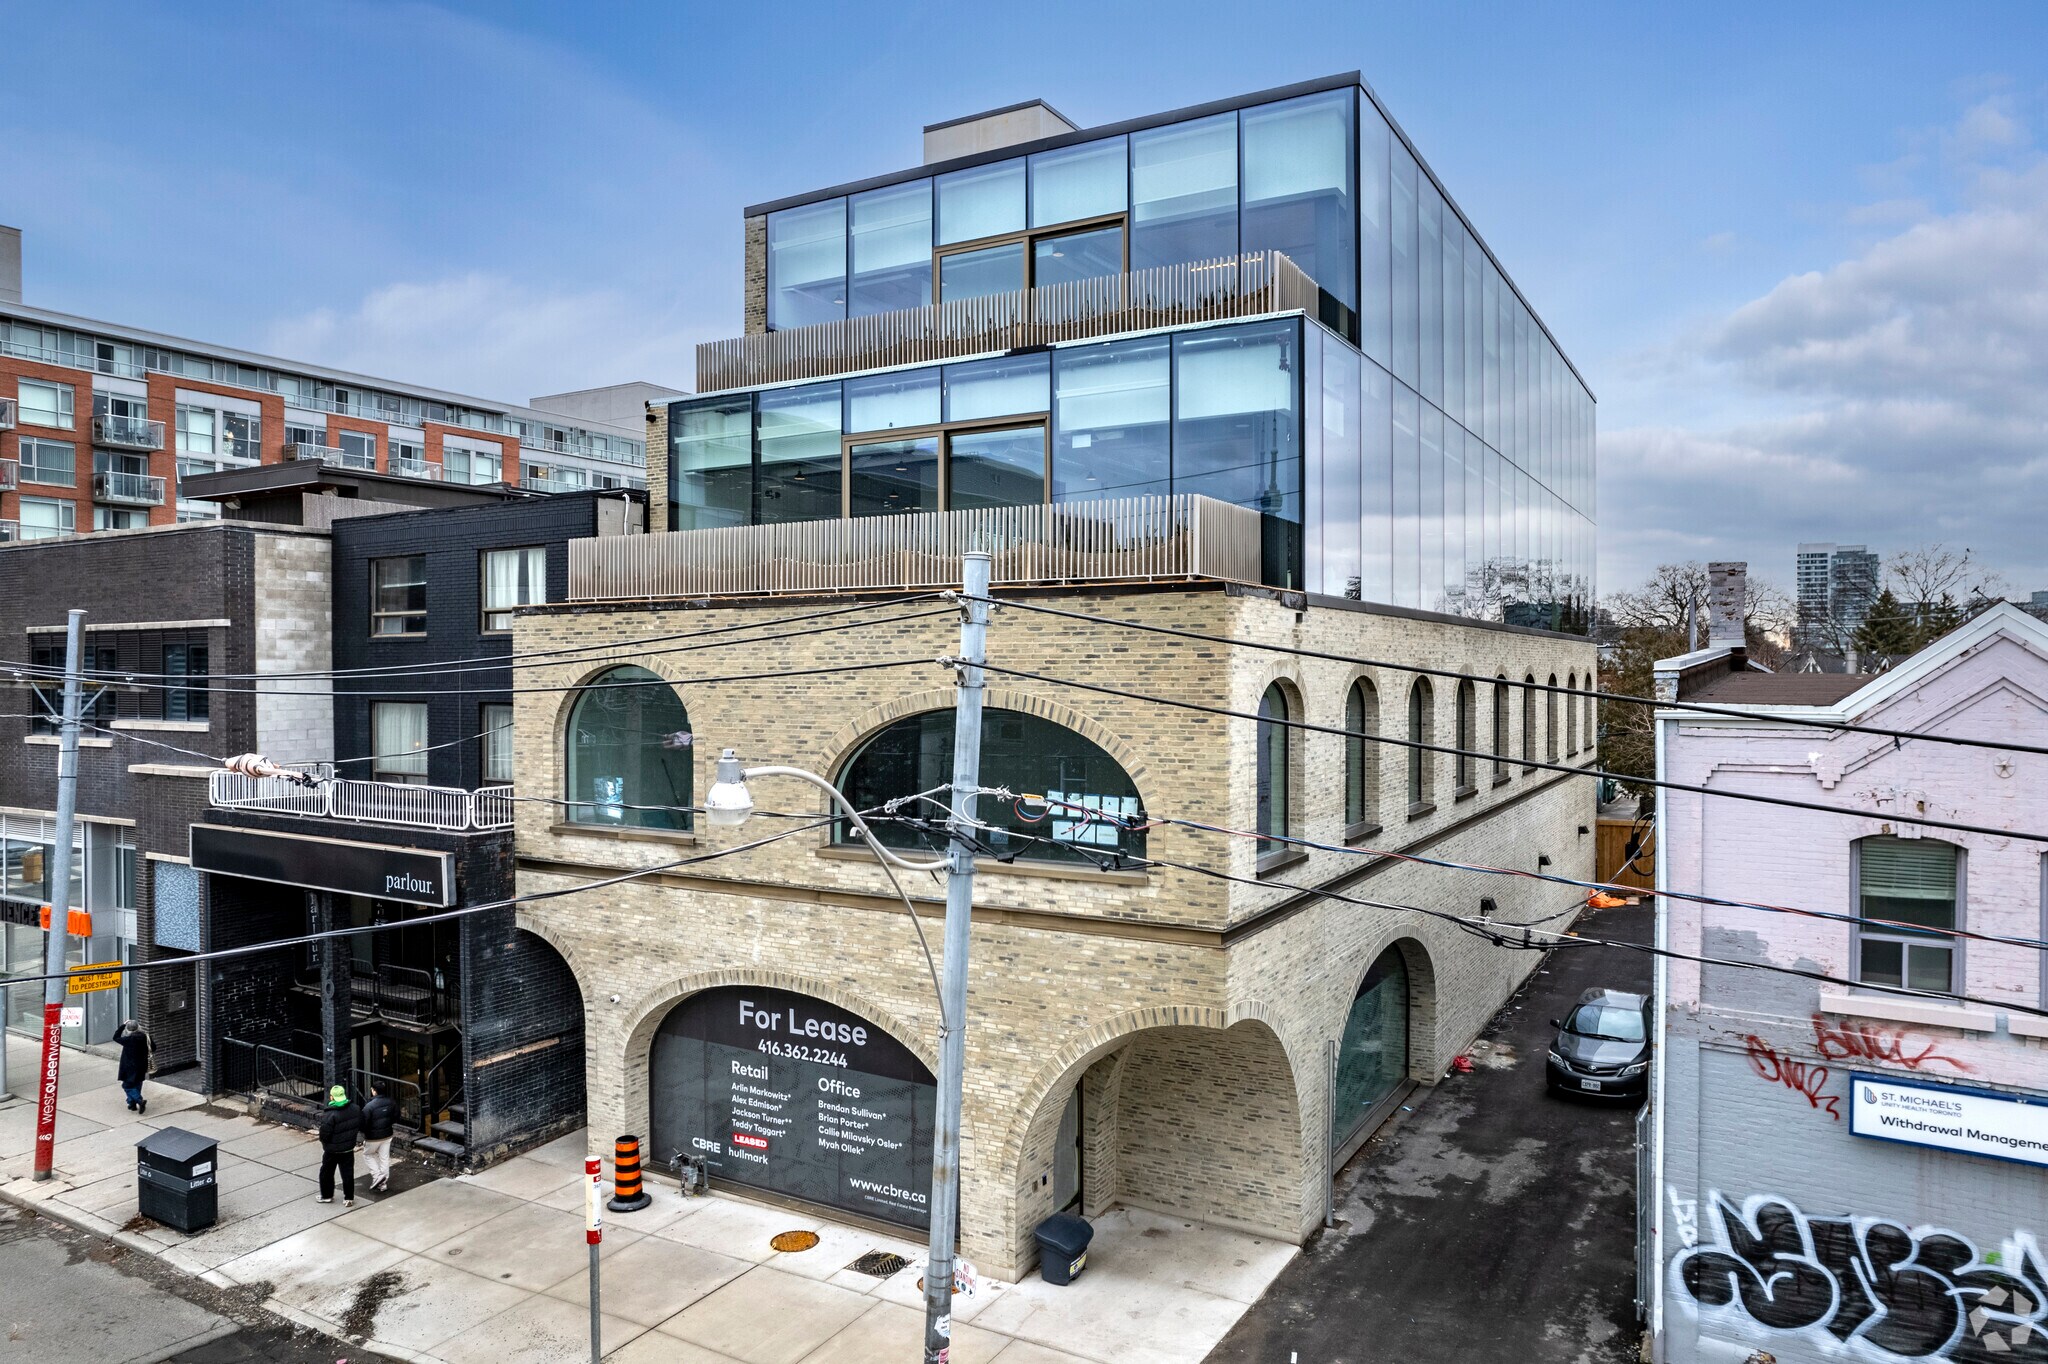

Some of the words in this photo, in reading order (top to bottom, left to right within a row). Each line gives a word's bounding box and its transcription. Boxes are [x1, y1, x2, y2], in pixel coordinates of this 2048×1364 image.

[385, 873, 435, 894] parlour.
[80, 979, 119, 990] PEDESTRIANS
[739, 1000, 781, 1031] For
[789, 1008, 867, 1046] Lease
[758, 1039, 848, 1068] 416.362.2244
[731, 1060, 769, 1080] Retail
[731, 1082, 749, 1092] Arlin
[818, 1077, 861, 1098] Office
[731, 1094, 747, 1104] Alex
[818, 1100, 850, 1114] Brendan
[1881, 1092, 1897, 1102] ST.
[1900, 1094, 1962, 1111] MICHAEL'S
[731, 1107, 760, 1119] Jackson
[1881, 1101, 1901, 1109] UNITY
[1901, 1104, 1928, 1113] HEALTH
[1929, 1109, 1963, 1118] TORONTO
[731, 1118, 753, 1132] Teddy
[818, 1113, 839, 1124] Brian
[1880, 1114, 1963, 1138] Withdrawal
[734, 1134, 768, 1148] LEASED
[818, 1125, 840, 1137] Callie
[841, 1130, 875, 1146] Milavsky
[818, 1138, 840, 1150] Myah
[692, 1137, 721, 1153] CBRE
[728, 1146, 769, 1165] hullmark
[849, 1177, 926, 1204] www.cbre.ca
